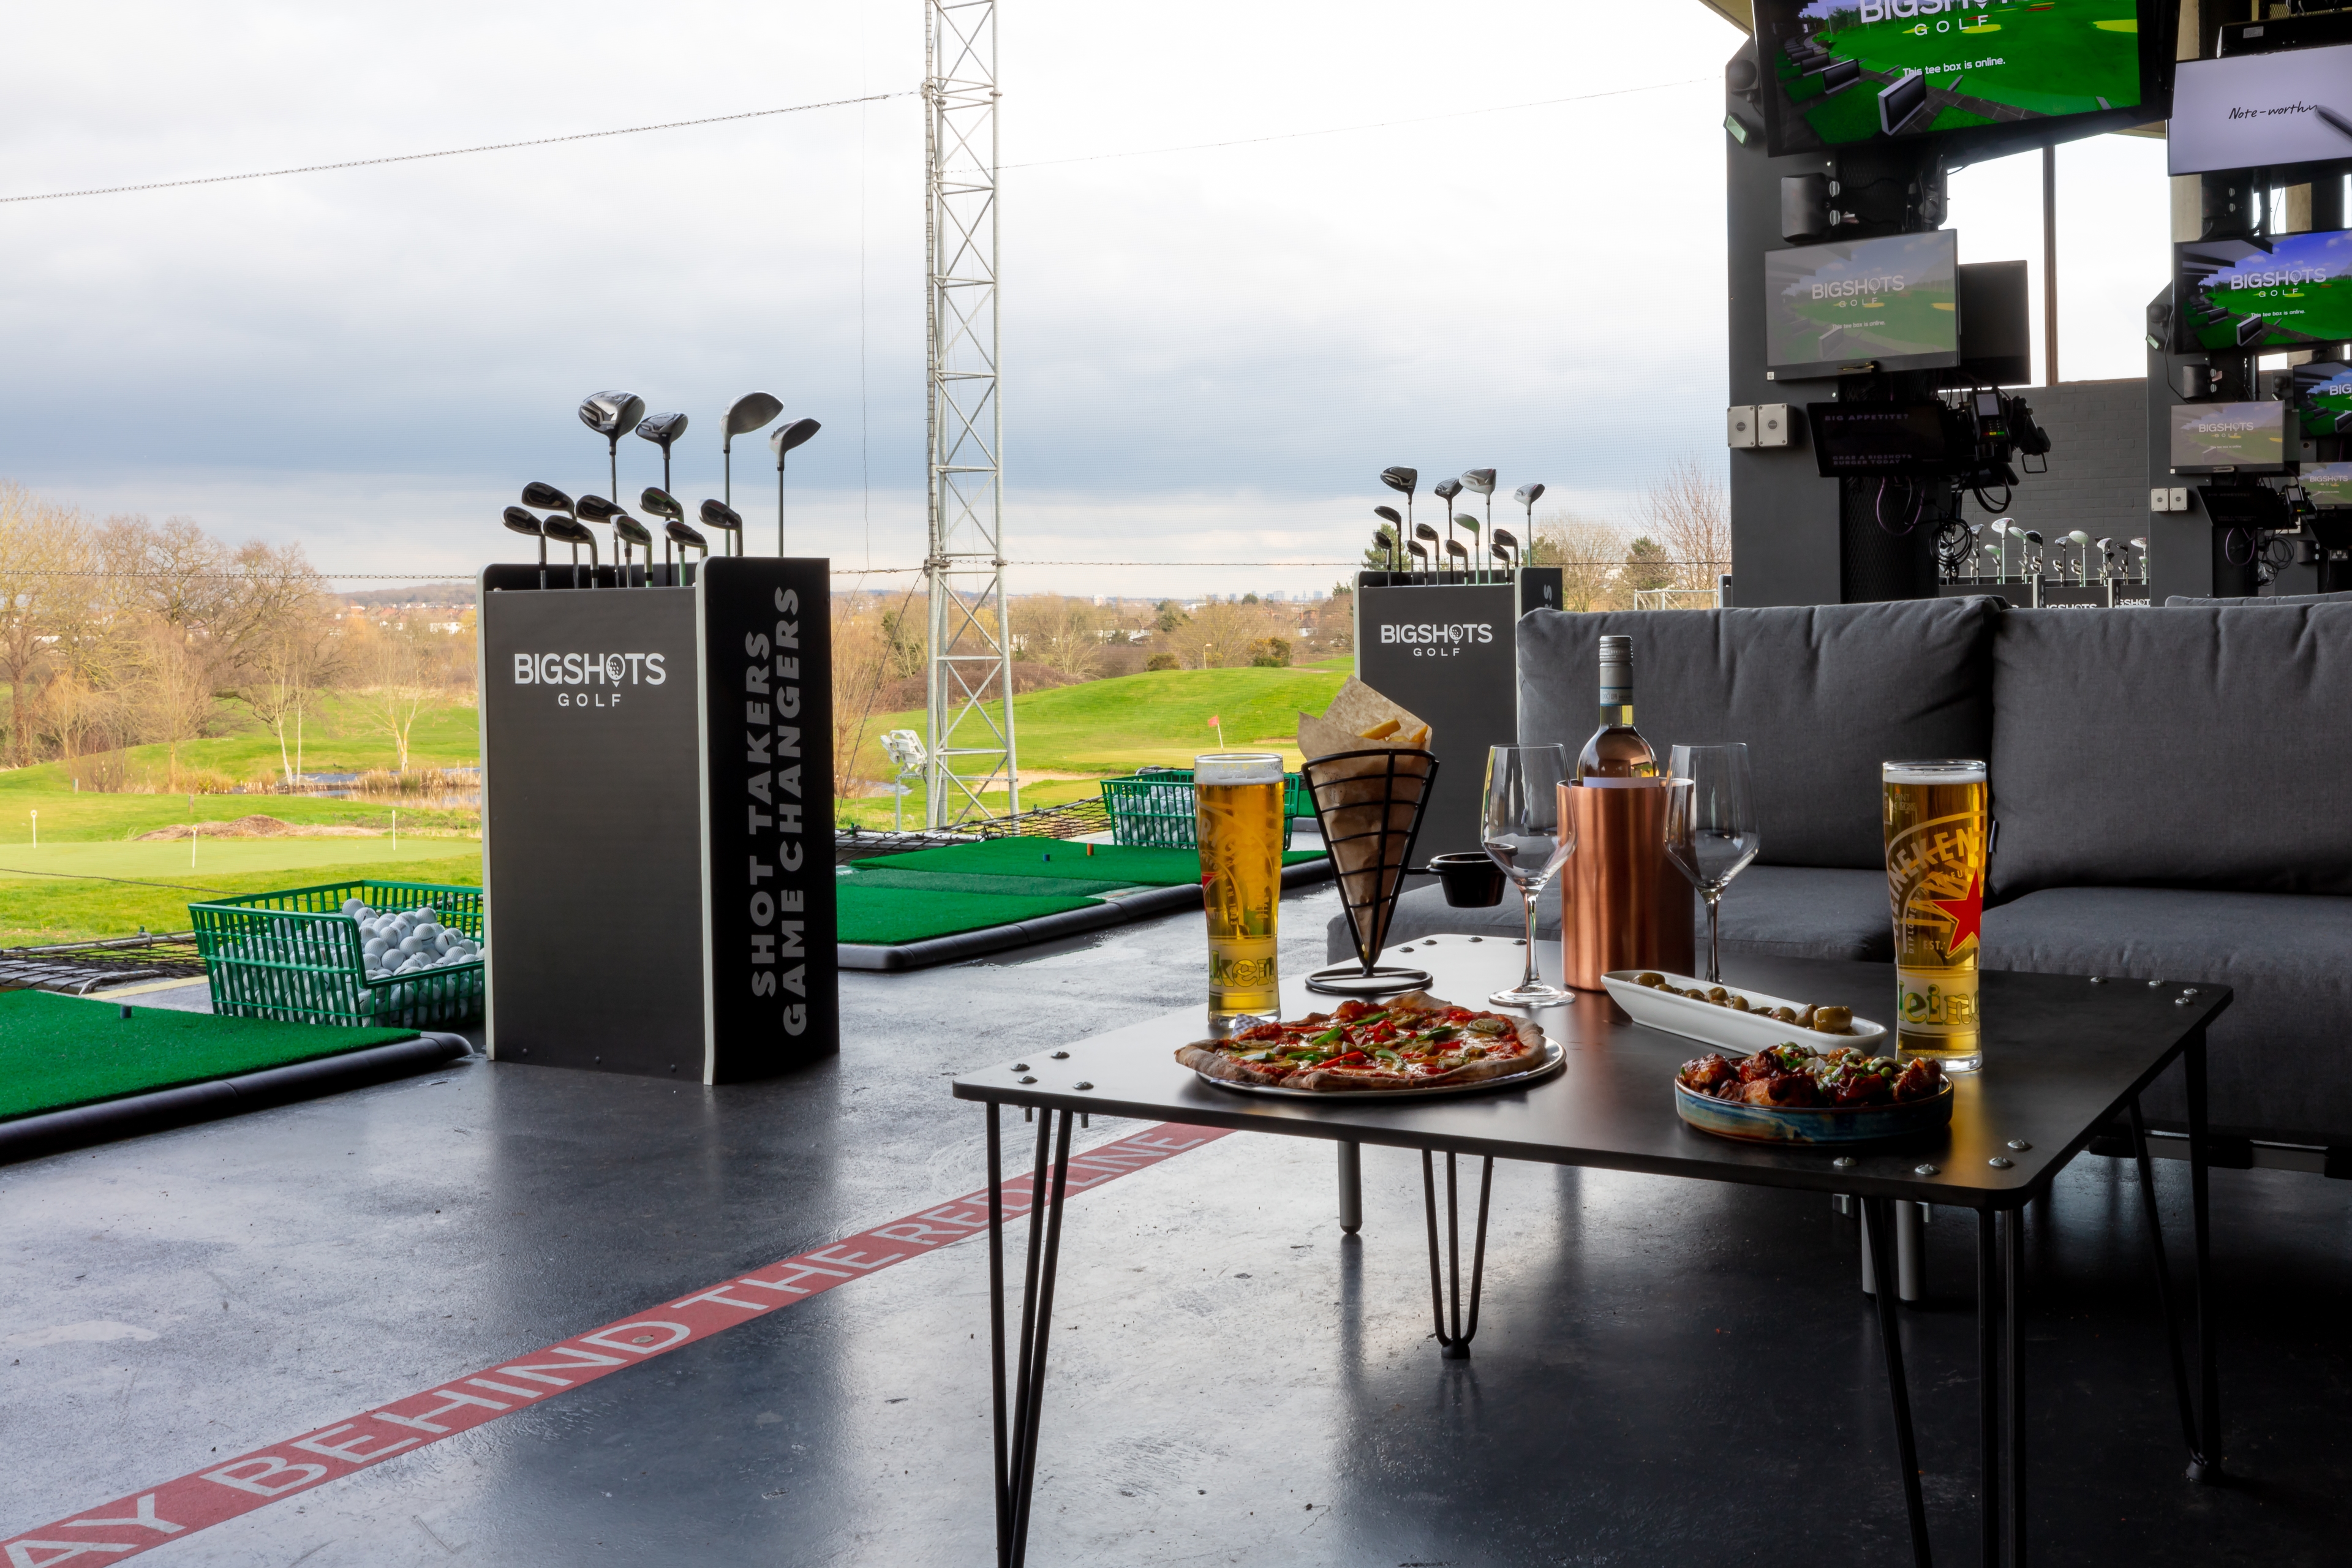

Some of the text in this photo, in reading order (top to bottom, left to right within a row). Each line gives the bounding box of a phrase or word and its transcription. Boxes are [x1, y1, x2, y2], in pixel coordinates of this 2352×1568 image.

[1914, 15, 1988, 36] GOLF
[1902, 57, 2006, 77] This tee box is online.
[1812, 275, 1905, 299] BIGSHOTS
[2231, 268, 2326, 290] BIGSHOTS
[1839, 297, 1878, 307] GOLF
[2258, 288, 2298, 298] GOLF
[2198, 422, 2254, 432] BIGSHOTS
[1381, 624, 1493, 644] BIGSHOTS
[1413, 647, 1460, 657] GOLF
[514, 653, 666, 687] BIGSHOTS
[557, 693, 622, 707] GOLF
[745, 630, 777, 998] SHOT TAKERS
[774, 586, 808, 1037] GAME CHANGERS
[198, 1321, 693, 1497] BEHIND
[671, 1244, 905, 1311] THE
